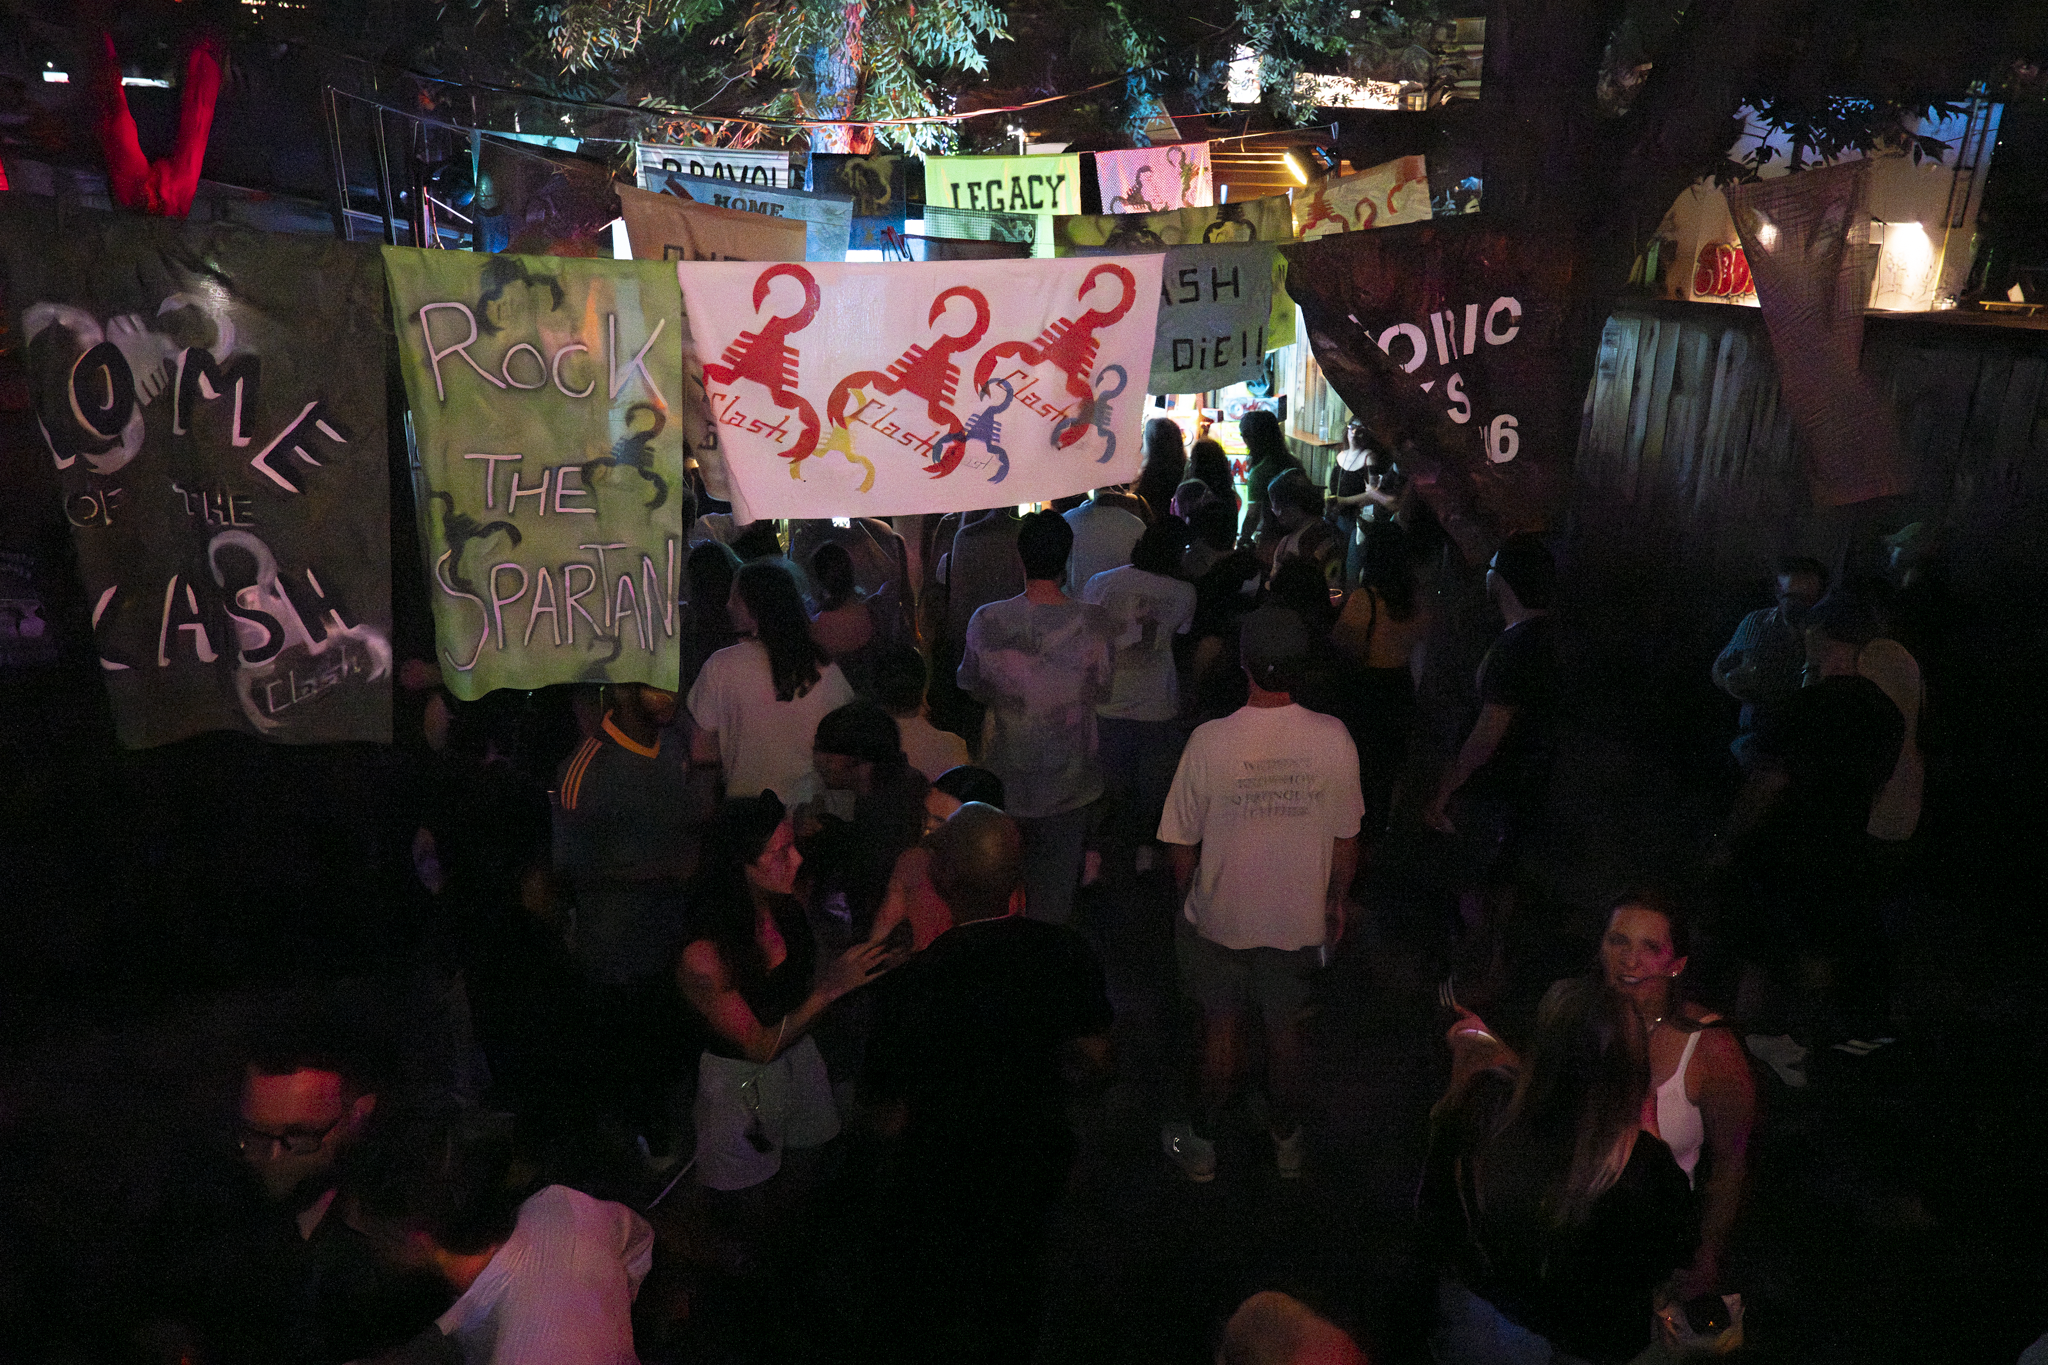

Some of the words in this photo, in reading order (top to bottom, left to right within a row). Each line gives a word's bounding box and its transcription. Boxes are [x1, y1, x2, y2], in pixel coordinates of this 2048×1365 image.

[713, 194, 785, 218] HOME
[951, 174, 1066, 211] LEGACY
[709, 391, 789, 445] Clash
[997, 369, 1072, 424] Clash
[849, 397, 940, 458] Clash
[64, 486, 121, 528] OF
[171, 482, 254, 526] THE
[463, 453, 597, 516] THE
